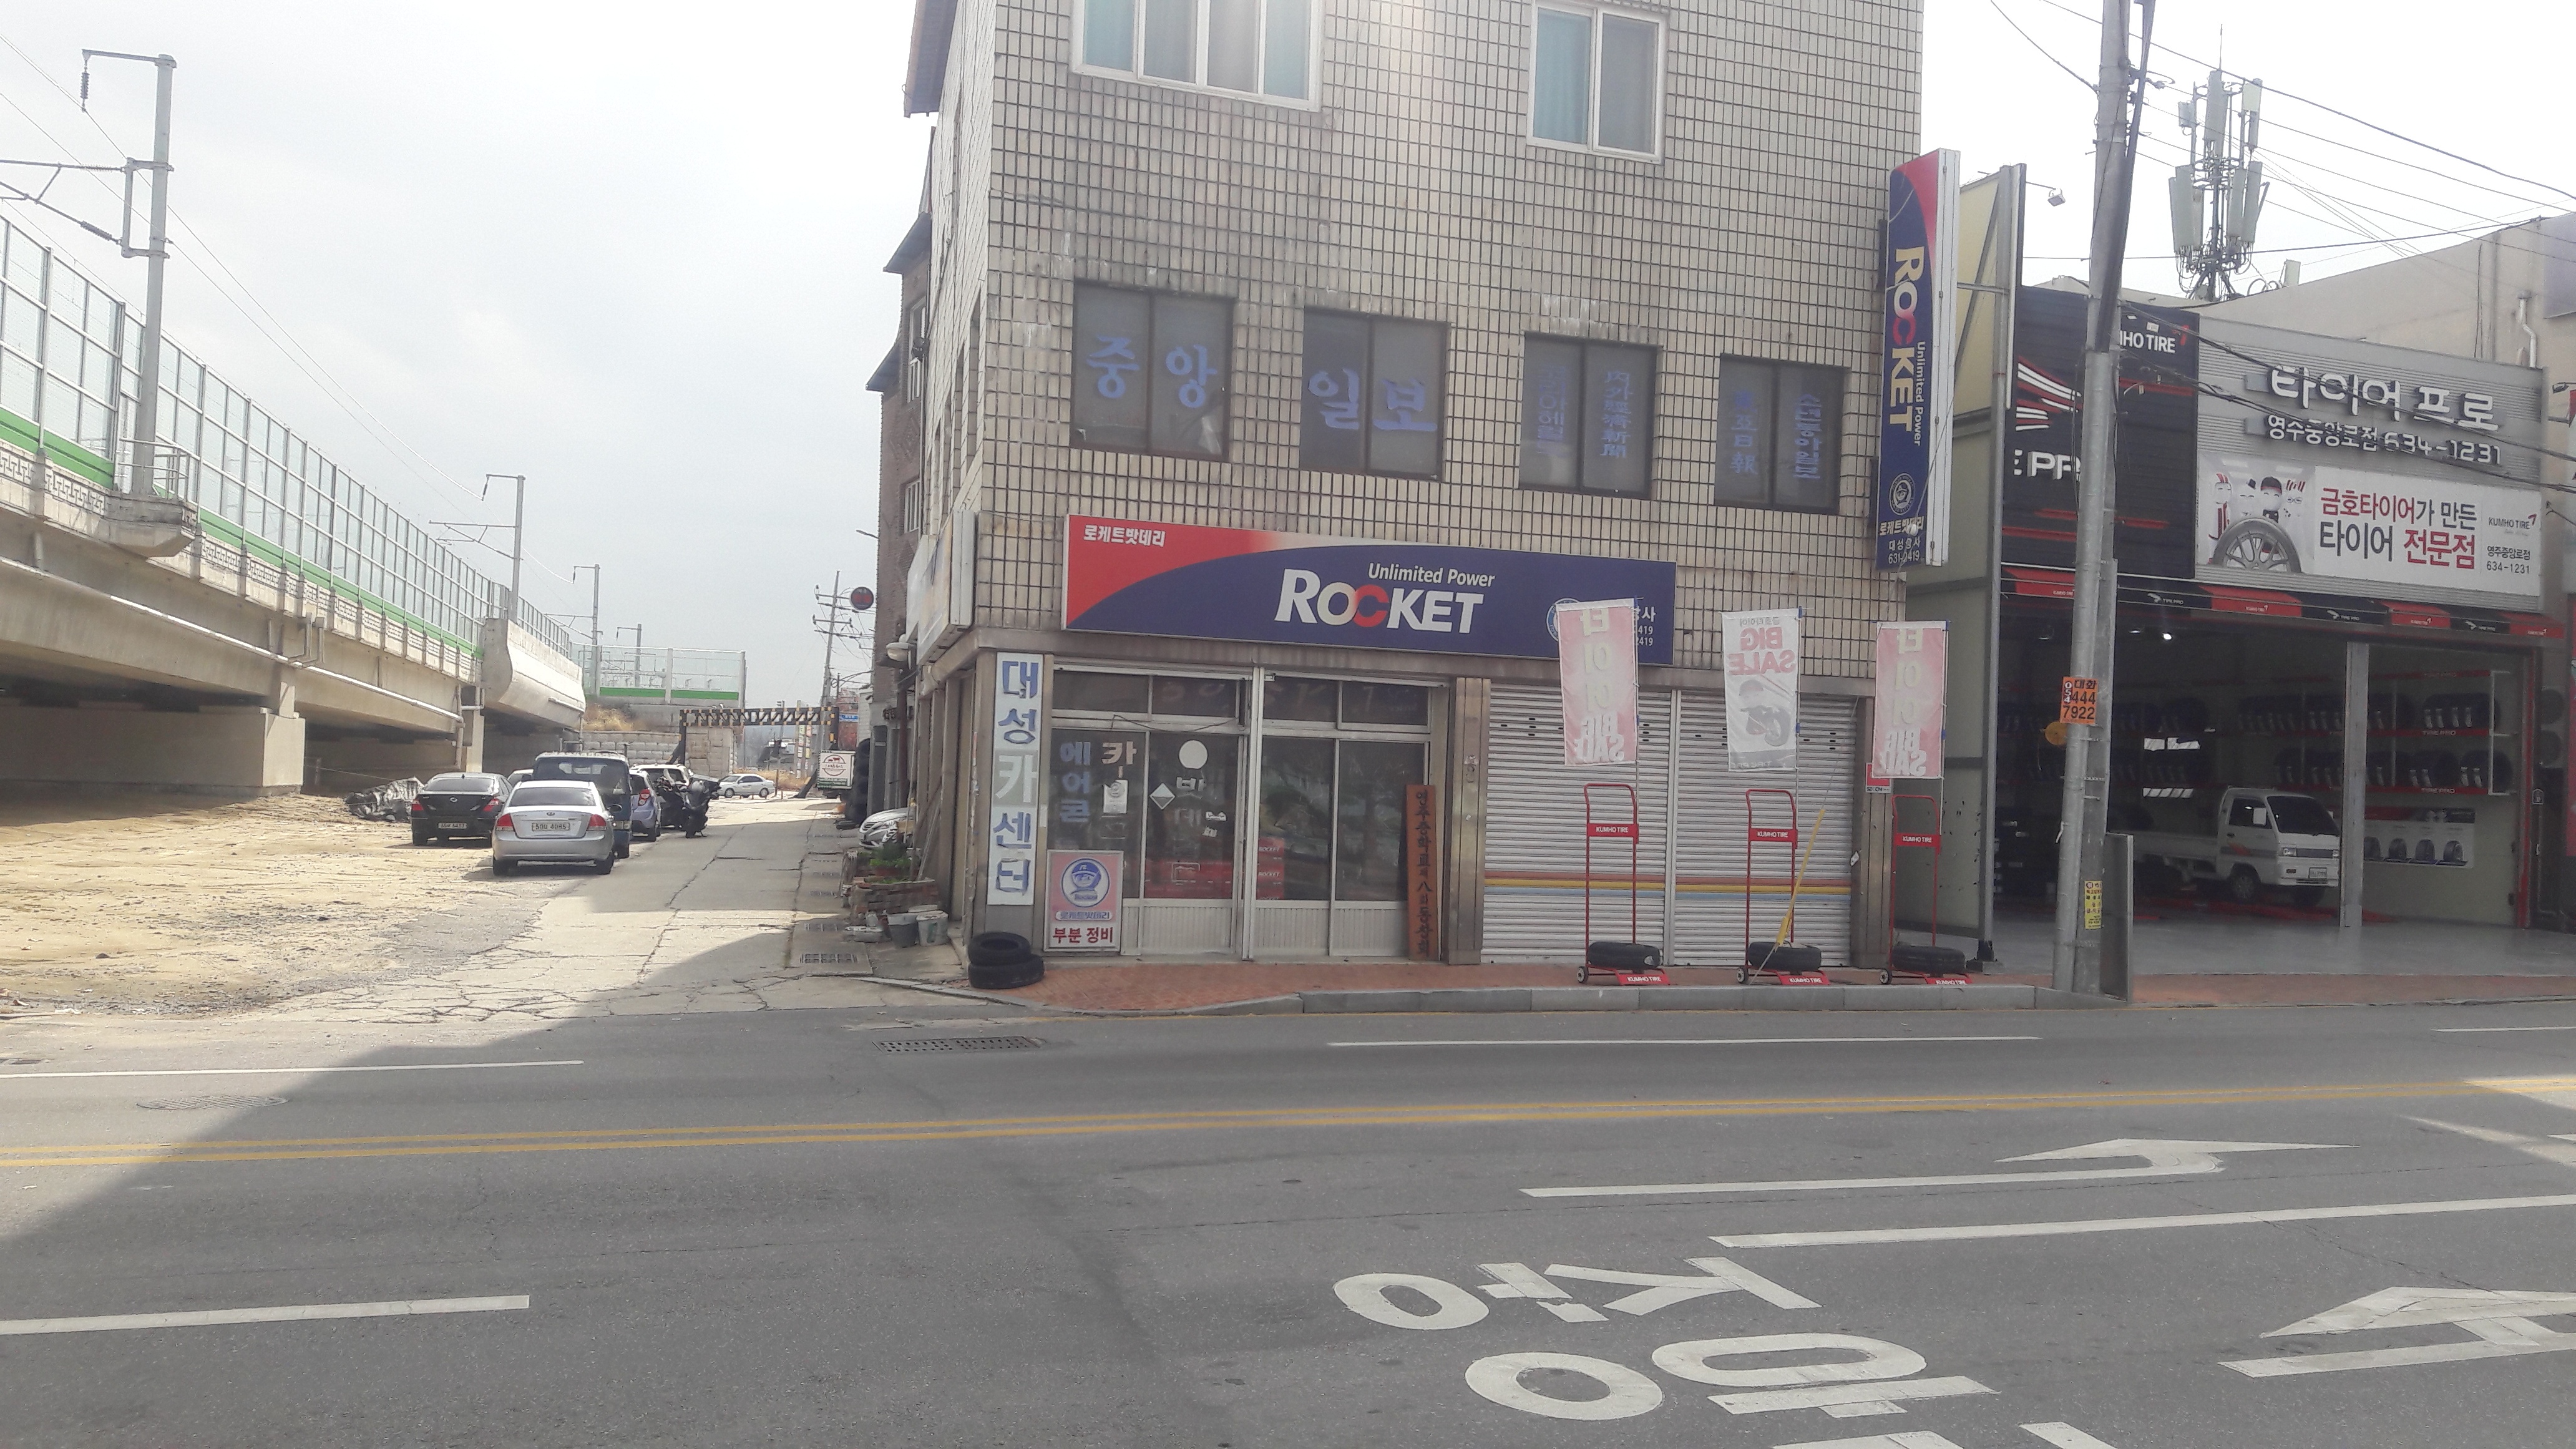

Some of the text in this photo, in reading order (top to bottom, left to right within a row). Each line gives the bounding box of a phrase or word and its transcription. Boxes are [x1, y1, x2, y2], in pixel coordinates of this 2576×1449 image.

[1889, 246, 1925, 432] ROCKET
[2146, 333, 2176, 354] TIRE
[1086, 334, 1438, 431] 중앙 일보
[1913, 341, 1926, 446] Unlimited Power
[2271, 364, 2499, 432] 타이어 프로
[2384, 431, 2501, 465] 634-1231
[2320, 487, 2477, 531] 금호타이어가 만든
[1083, 524, 1166, 547] 로케트밧데리
[2320, 519, 2476, 569] 타이어 전문점
[1368, 562, 1496, 588] Unlimited Power
[2486, 560, 2530, 574] 634-1231
[1274, 567, 1485, 635] ROCKET
[2064, 681, 2072, 703] 054
[2071, 691, 2096, 705] 444
[2062, 705, 2095, 720] 7922
[993, 660, 1039, 896] 대성카센터
[1053, 927, 1113, 944] 부분 정비
